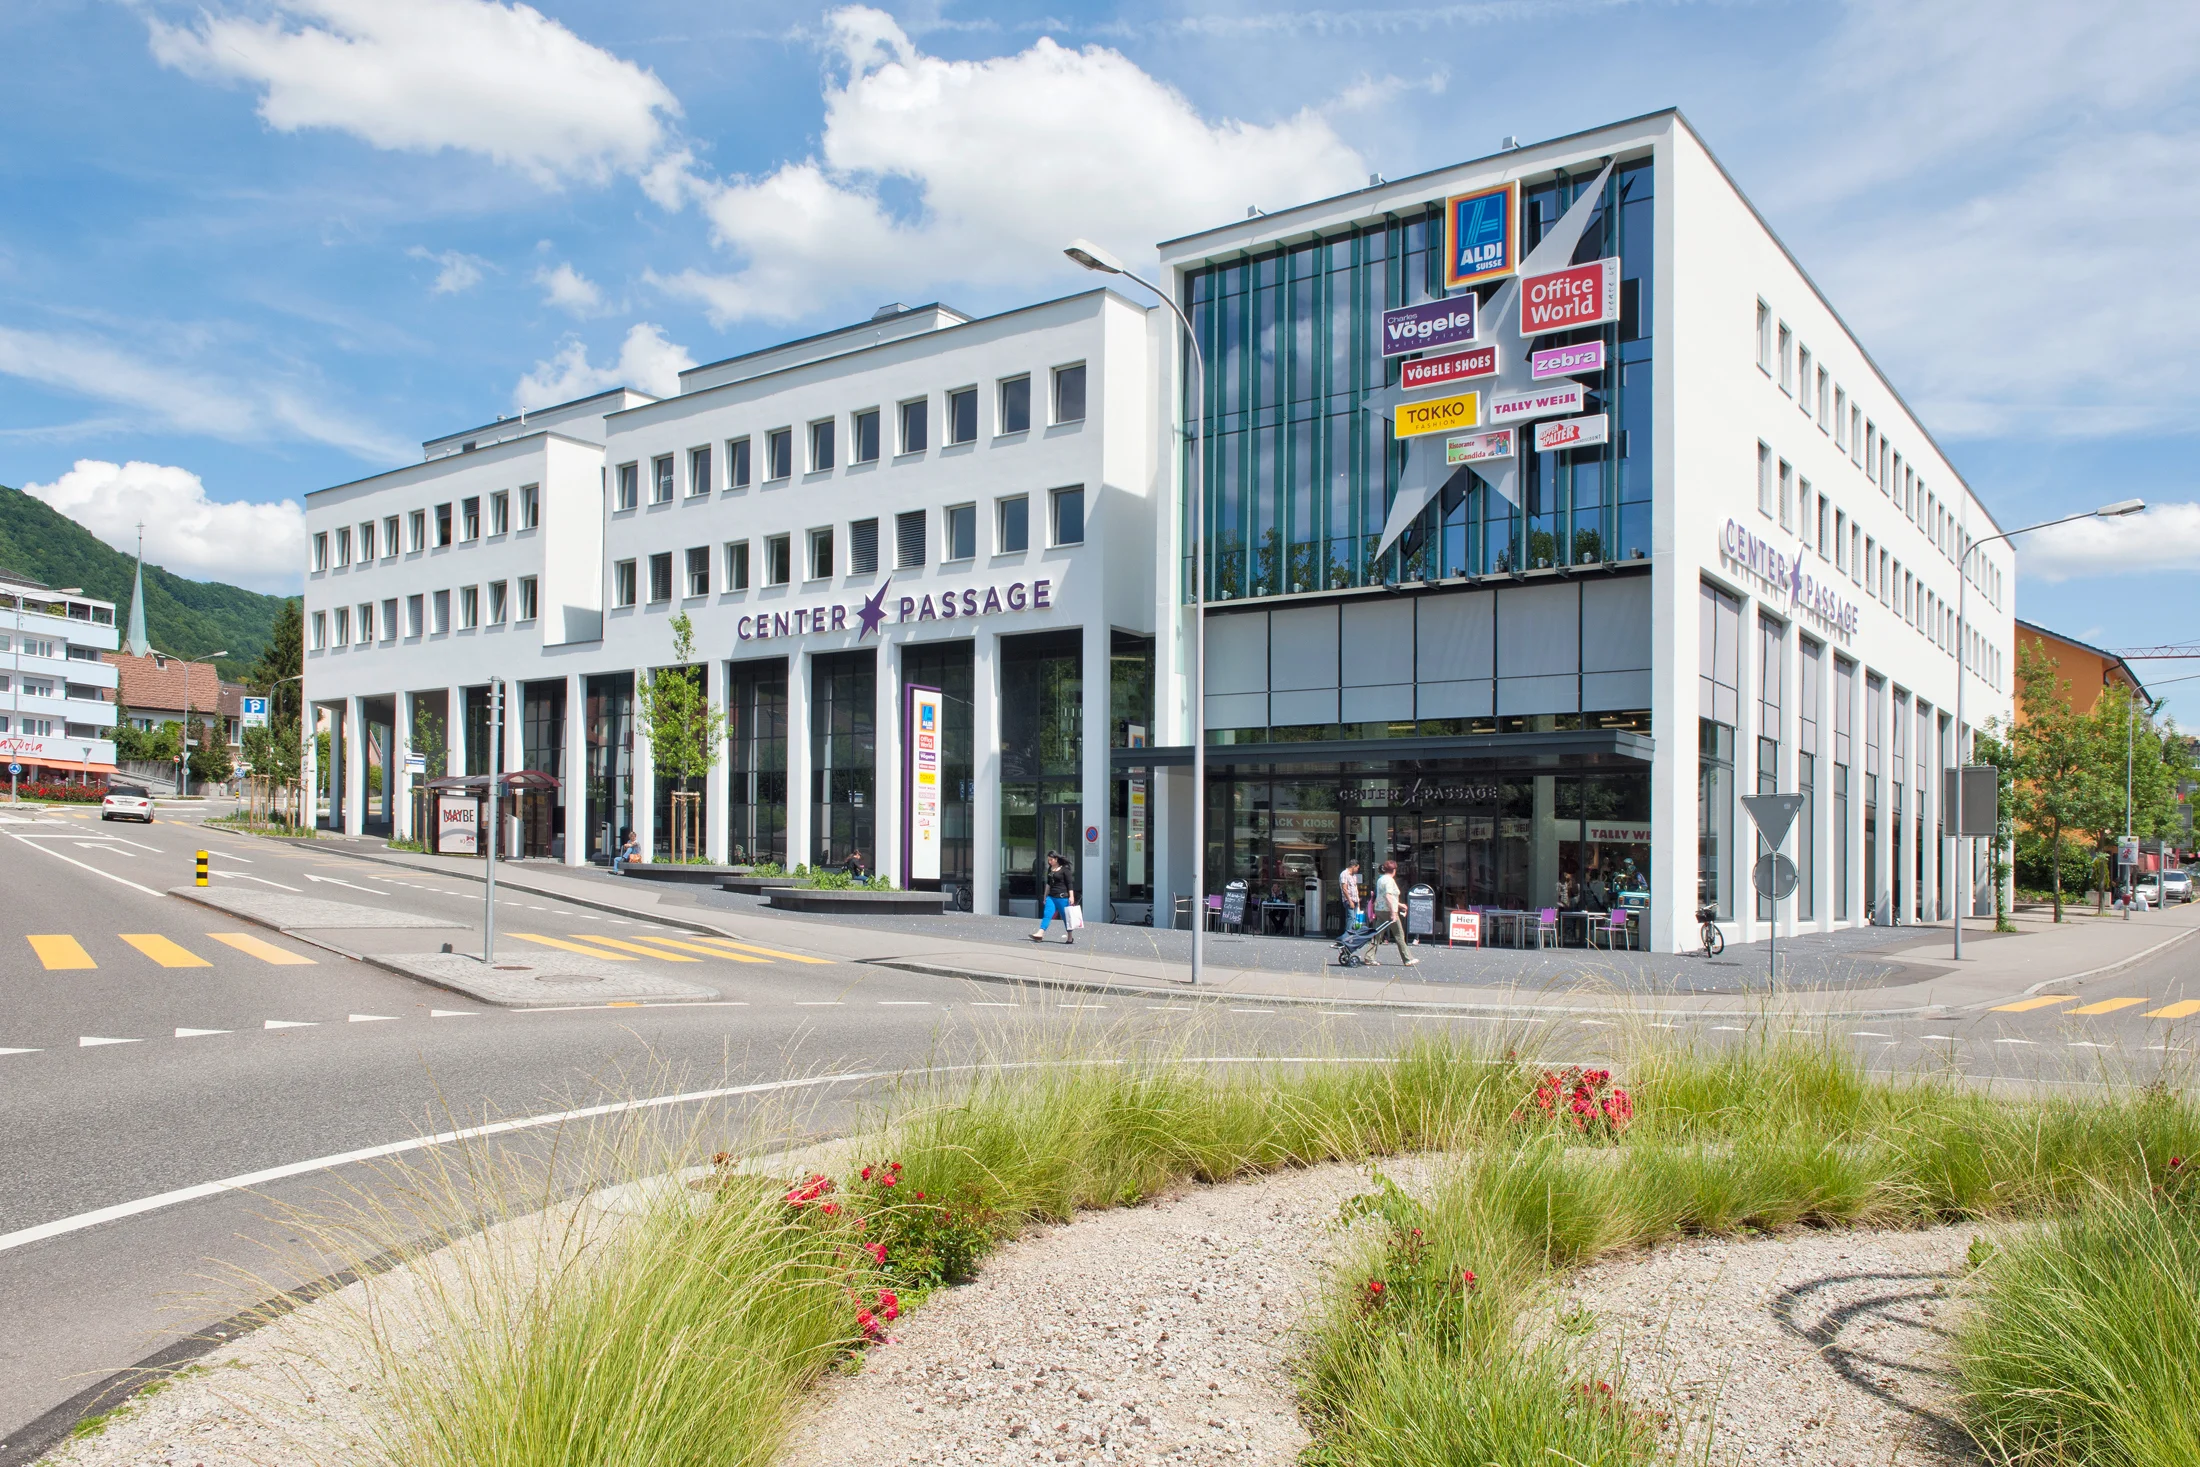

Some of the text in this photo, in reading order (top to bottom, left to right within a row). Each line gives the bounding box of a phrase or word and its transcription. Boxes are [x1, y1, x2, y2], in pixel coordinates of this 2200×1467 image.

[1460, 241, 1503, 267] ALDI
[1475, 258, 1503, 272] SUISSE
[1530, 277, 1594, 303] Office
[1530, 294, 1595, 324] World
[1387, 313, 1418, 325] Charles
[1387, 312, 1471, 340] Vögele
[1387, 329, 1471, 350] Switzerland
[1407, 355, 1491, 381] VÖGELE SHOES
[1536, 351, 1597, 371] zebra
[1494, 400, 1533, 415] TALLY
[1415, 419, 1456, 430] FASHION
[1448, 440, 1475, 450] Ristorante
[1448, 450, 1486, 463] La Candida
[1726, 518, 1859, 635] CENTER PASSAGE
[737, 579, 1052, 641] CENTER PASSAGE
[1340, 786, 1498, 801] CENTER PASSAGE
[443, 809, 475, 823] MAYBE
[1303, 818, 1335, 828] KIOSK
[1591, 829, 1629, 840] TALLY
[1453, 928, 1476, 937] Blick
